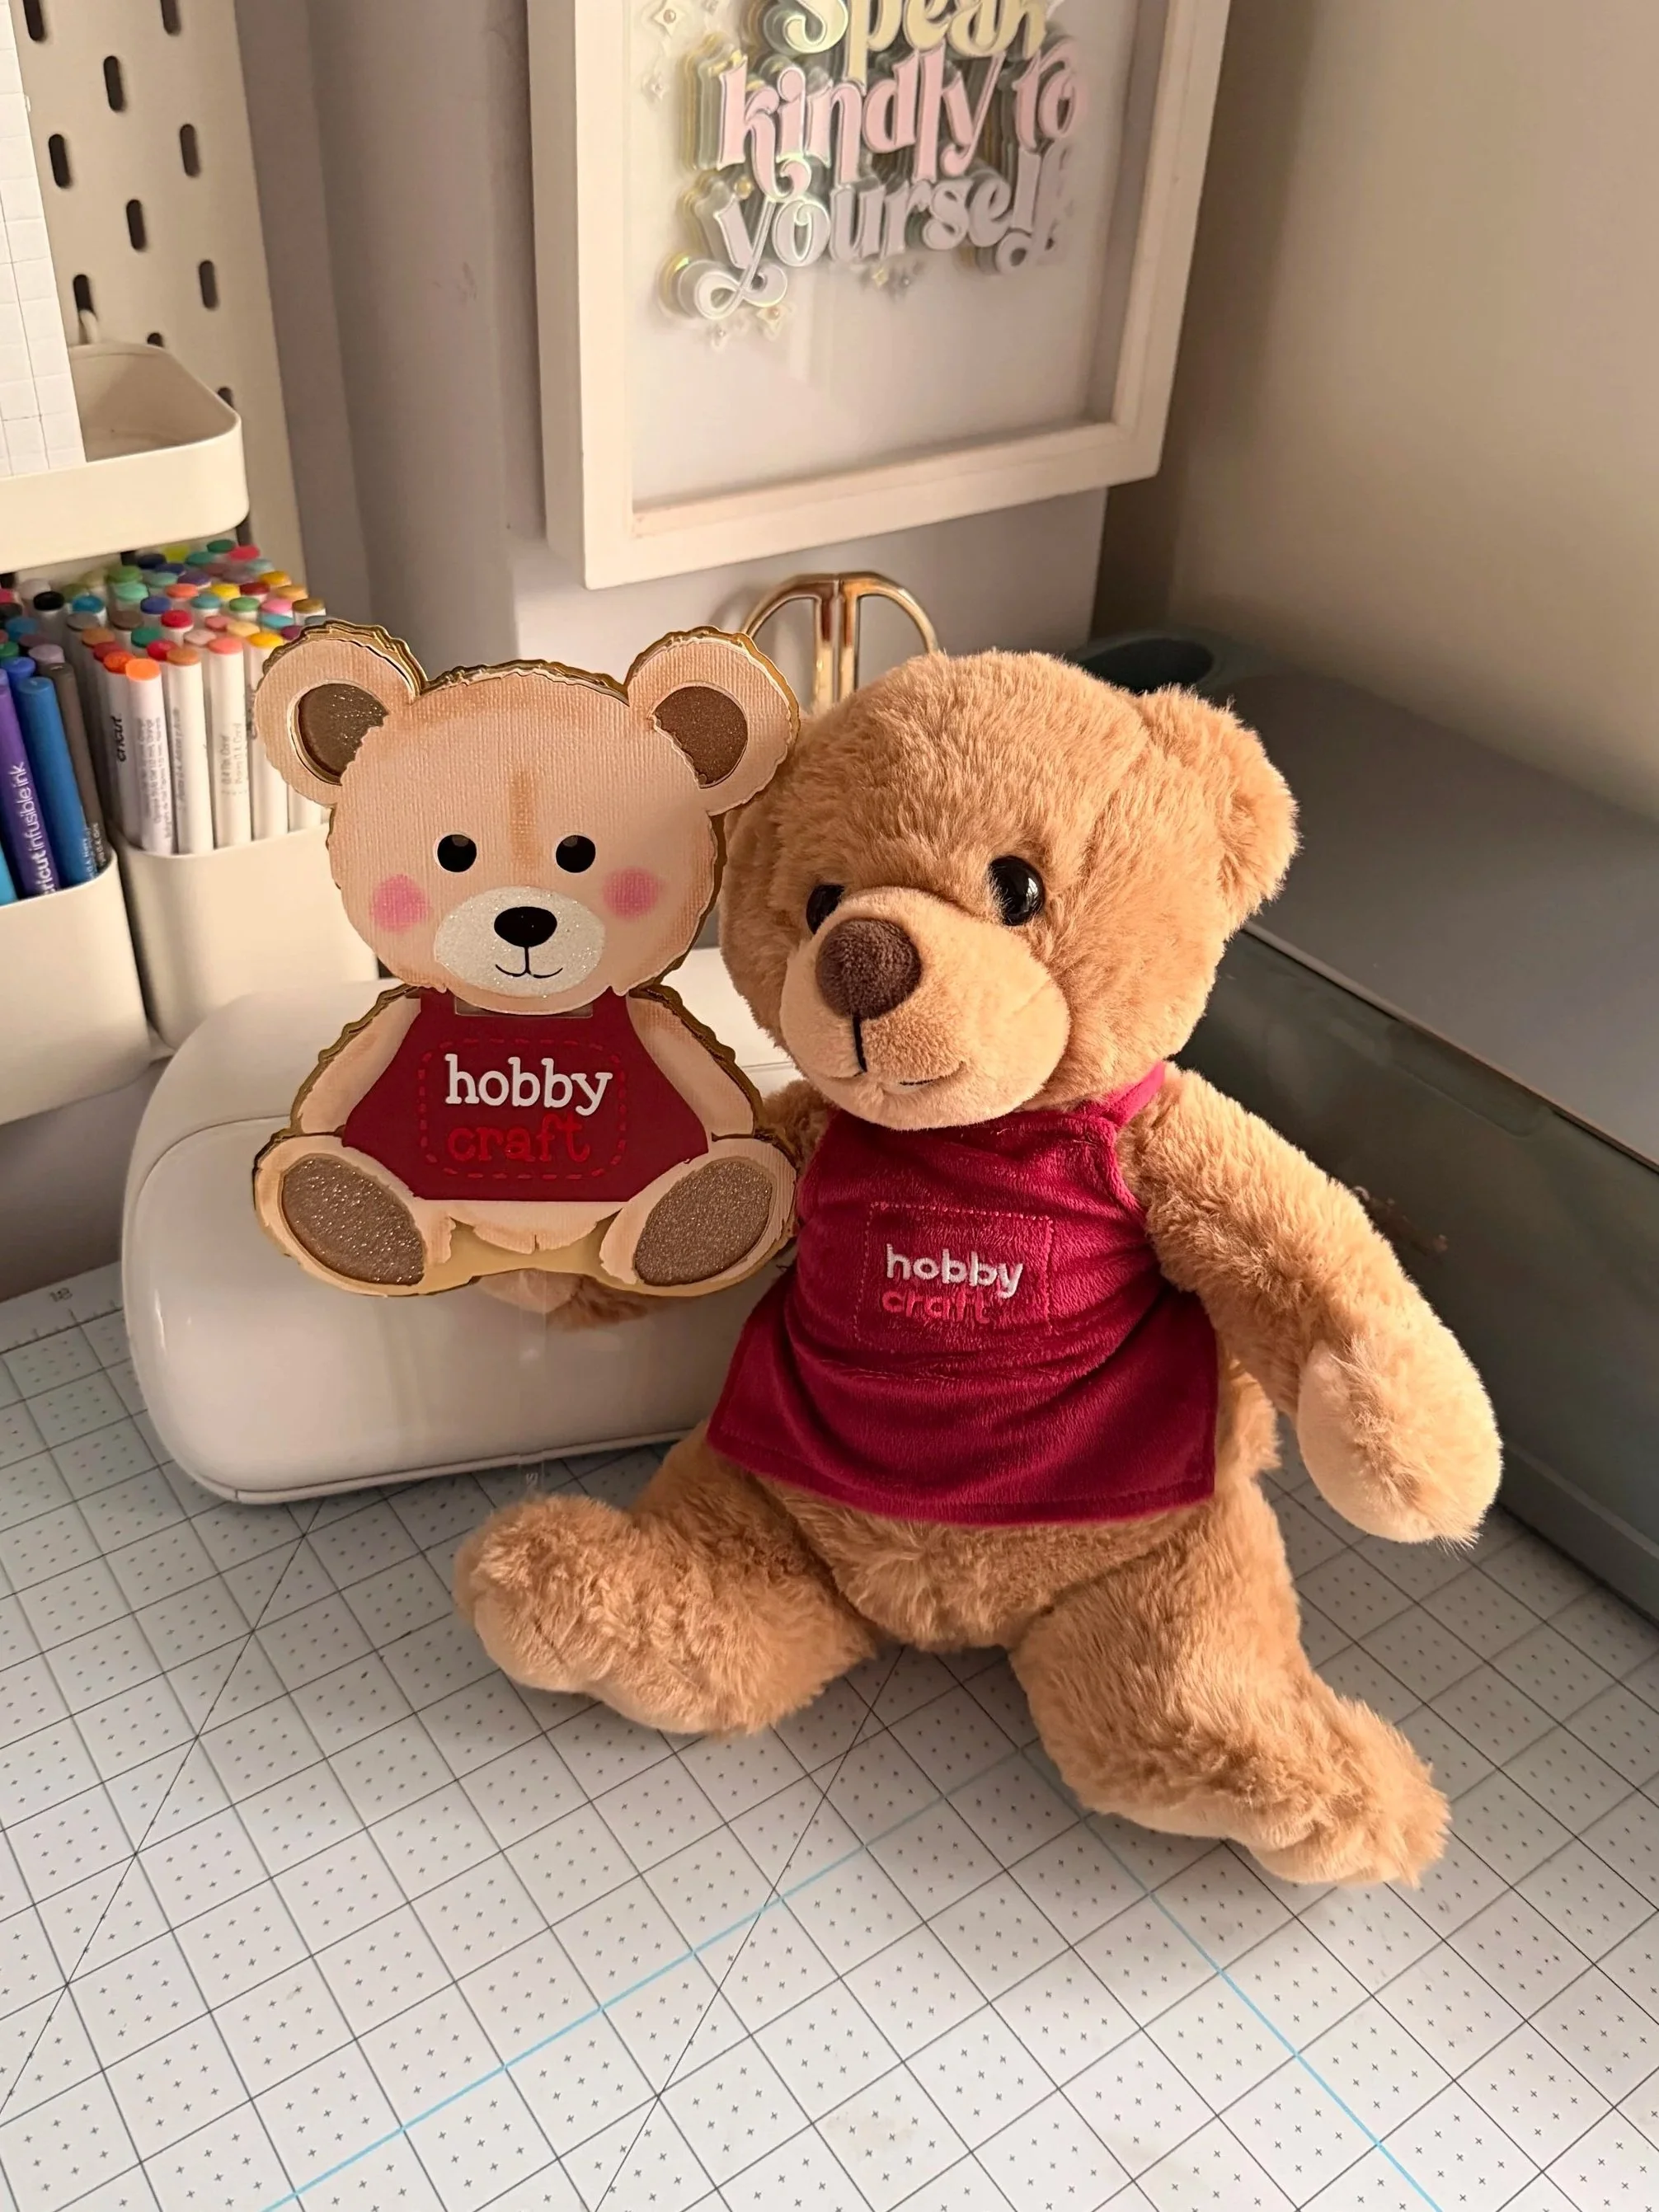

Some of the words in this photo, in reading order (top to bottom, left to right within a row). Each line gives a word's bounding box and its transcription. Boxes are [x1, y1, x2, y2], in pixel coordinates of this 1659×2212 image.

[716, 45, 1008, 202] kindly
[1012, 41, 1087, 153] to
[693, 142, 1072, 322] yourself
[110, 714, 127, 762] cricut
[9, 761, 30, 787] ink
[16, 786, 45, 851] infusible
[444, 1053, 613, 1116] hobby
[448, 1113, 591, 1162] craft
[886, 1242, 1024, 1299] hobby
[881, 1286, 992, 1324] craft
